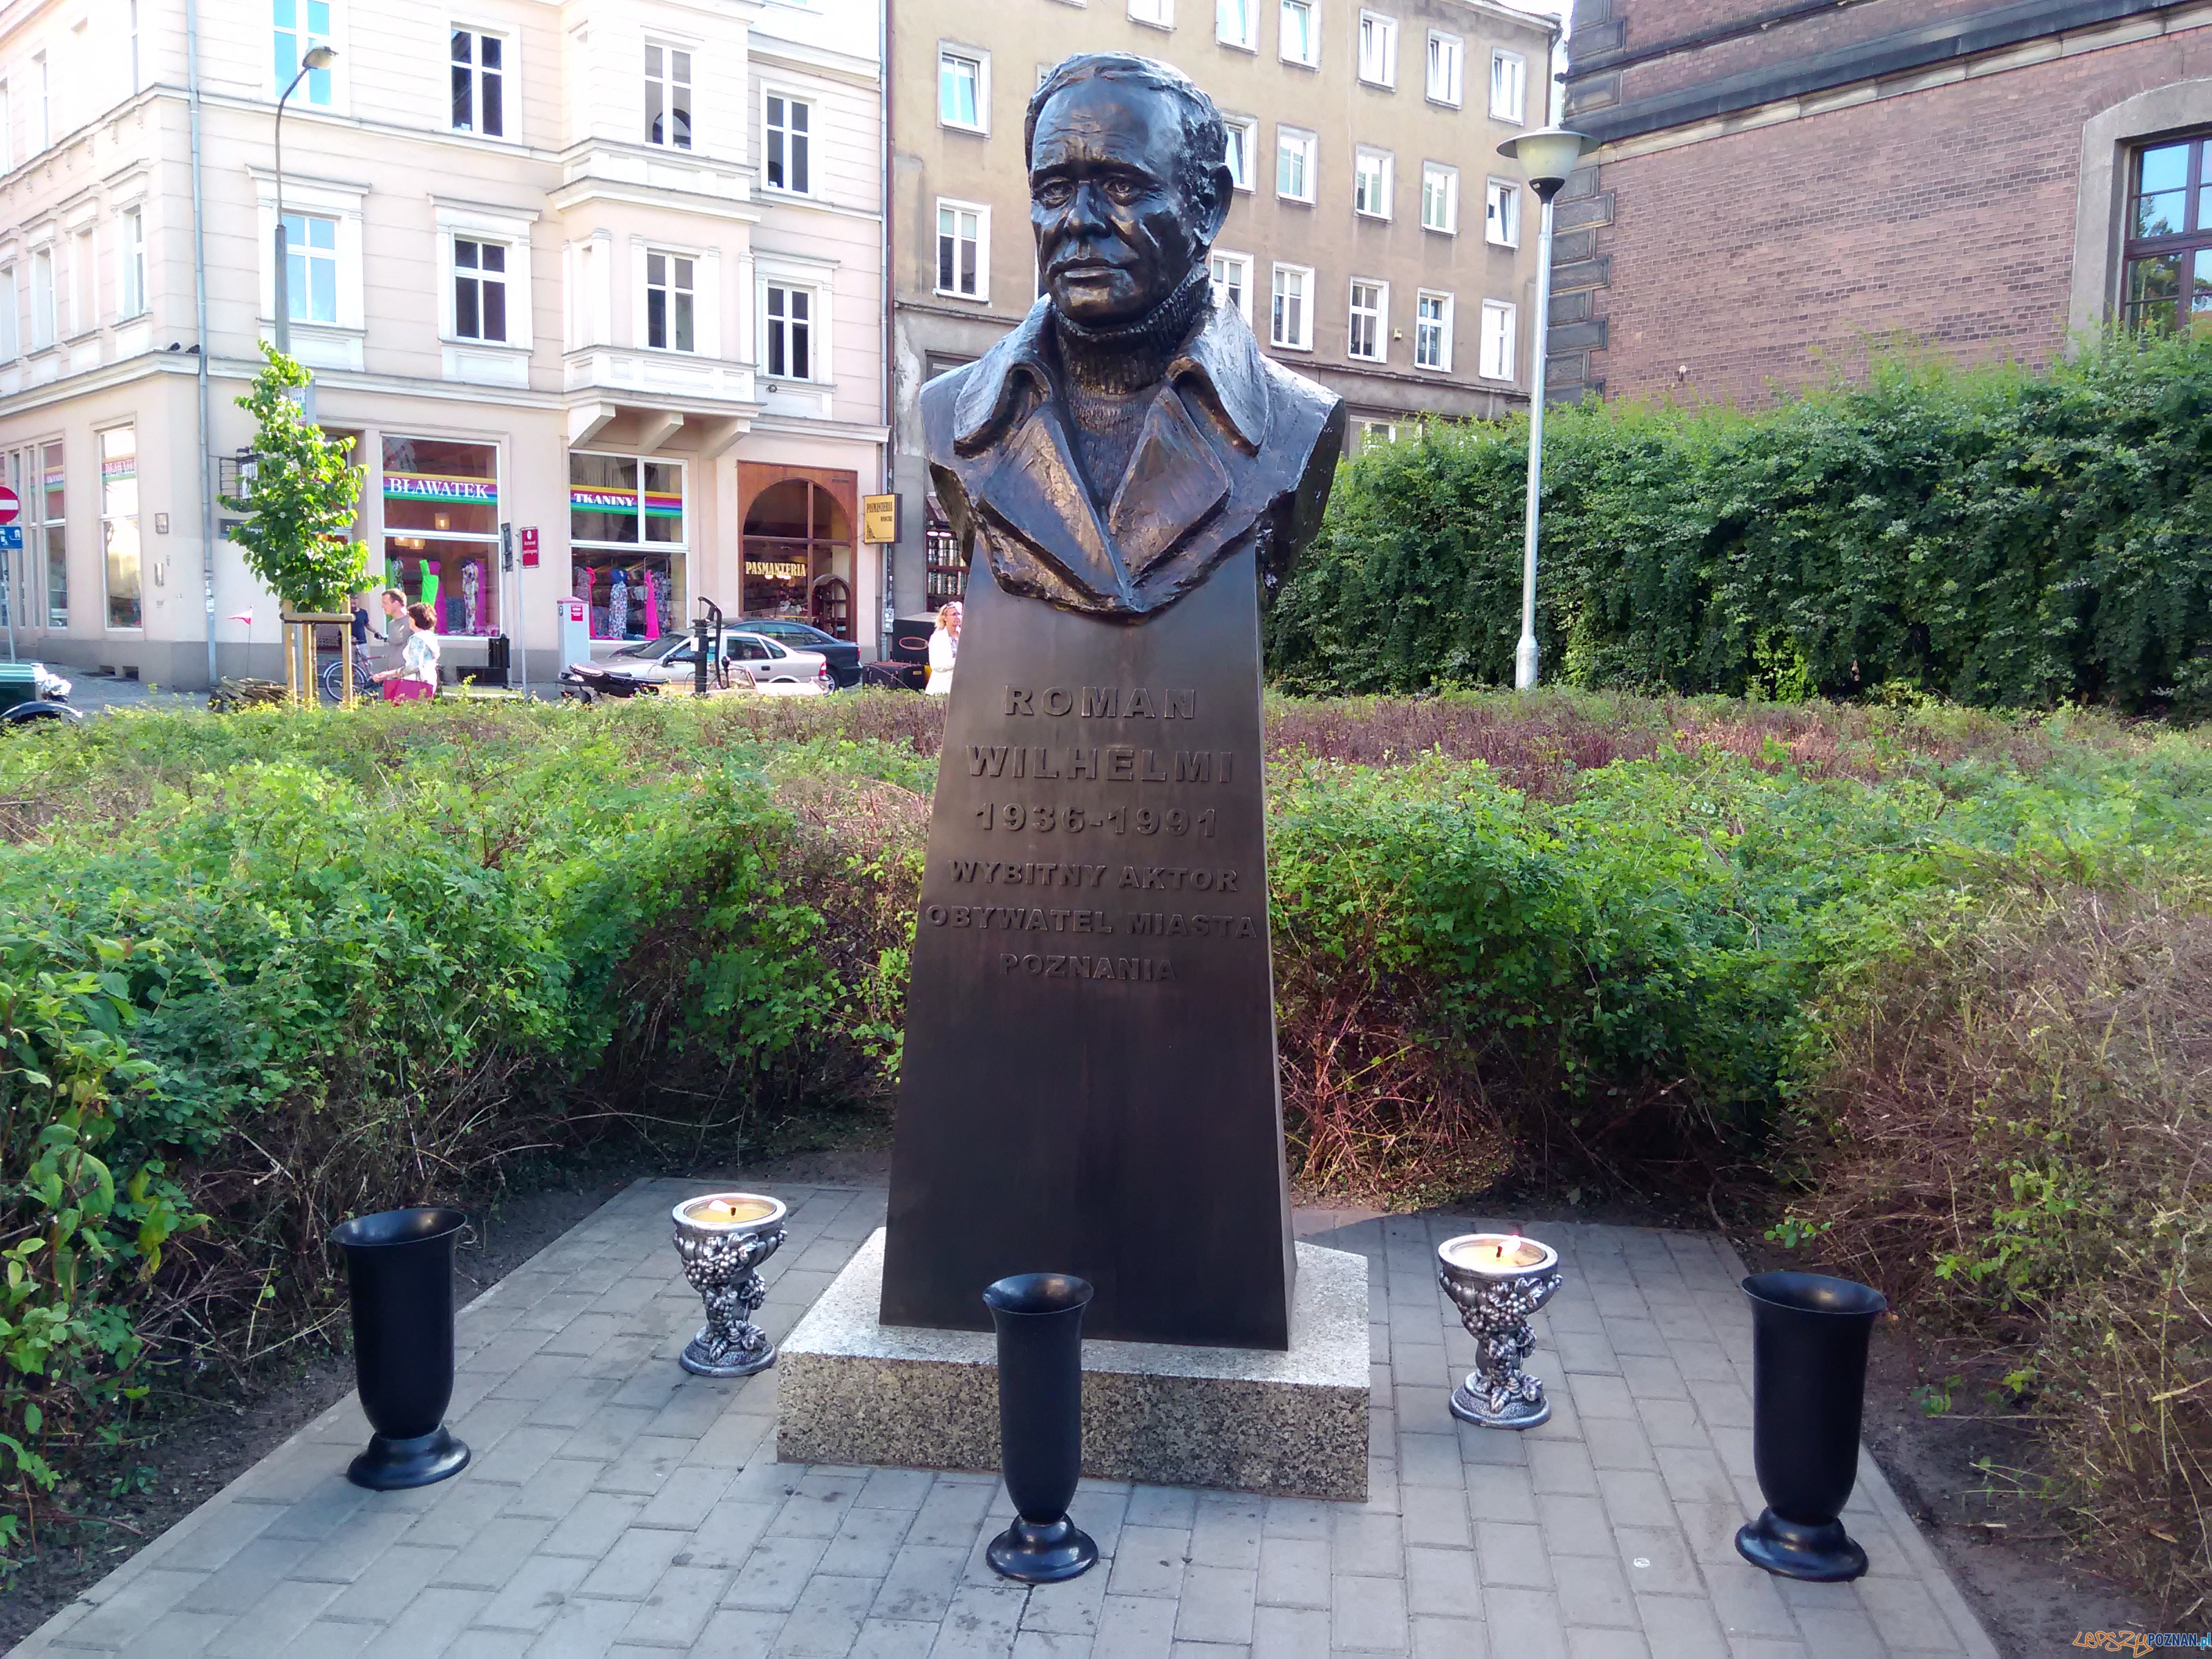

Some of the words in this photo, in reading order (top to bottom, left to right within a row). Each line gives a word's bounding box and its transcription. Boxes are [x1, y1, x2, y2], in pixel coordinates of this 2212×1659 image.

[388, 478, 488, 499] BŁAWATEK
[574, 493, 634, 507] TKANINY
[866, 502, 892, 513] PASMANTERIA
[745, 561, 806, 577] PASMANTERIA
[1004, 685, 1195, 719] ROMAN
[967, 744, 1232, 782] WILHELMI
[975, 802, 1217, 837] 1936-1991
[948, 860, 1106, 888] WYBITNY
[1118, 866, 1237, 892] AKTOR
[925, 904, 1113, 934] OBYWATEL
[1126, 912, 1257, 939] MIASTA
[999, 953, 1176, 982] POZNANIA
